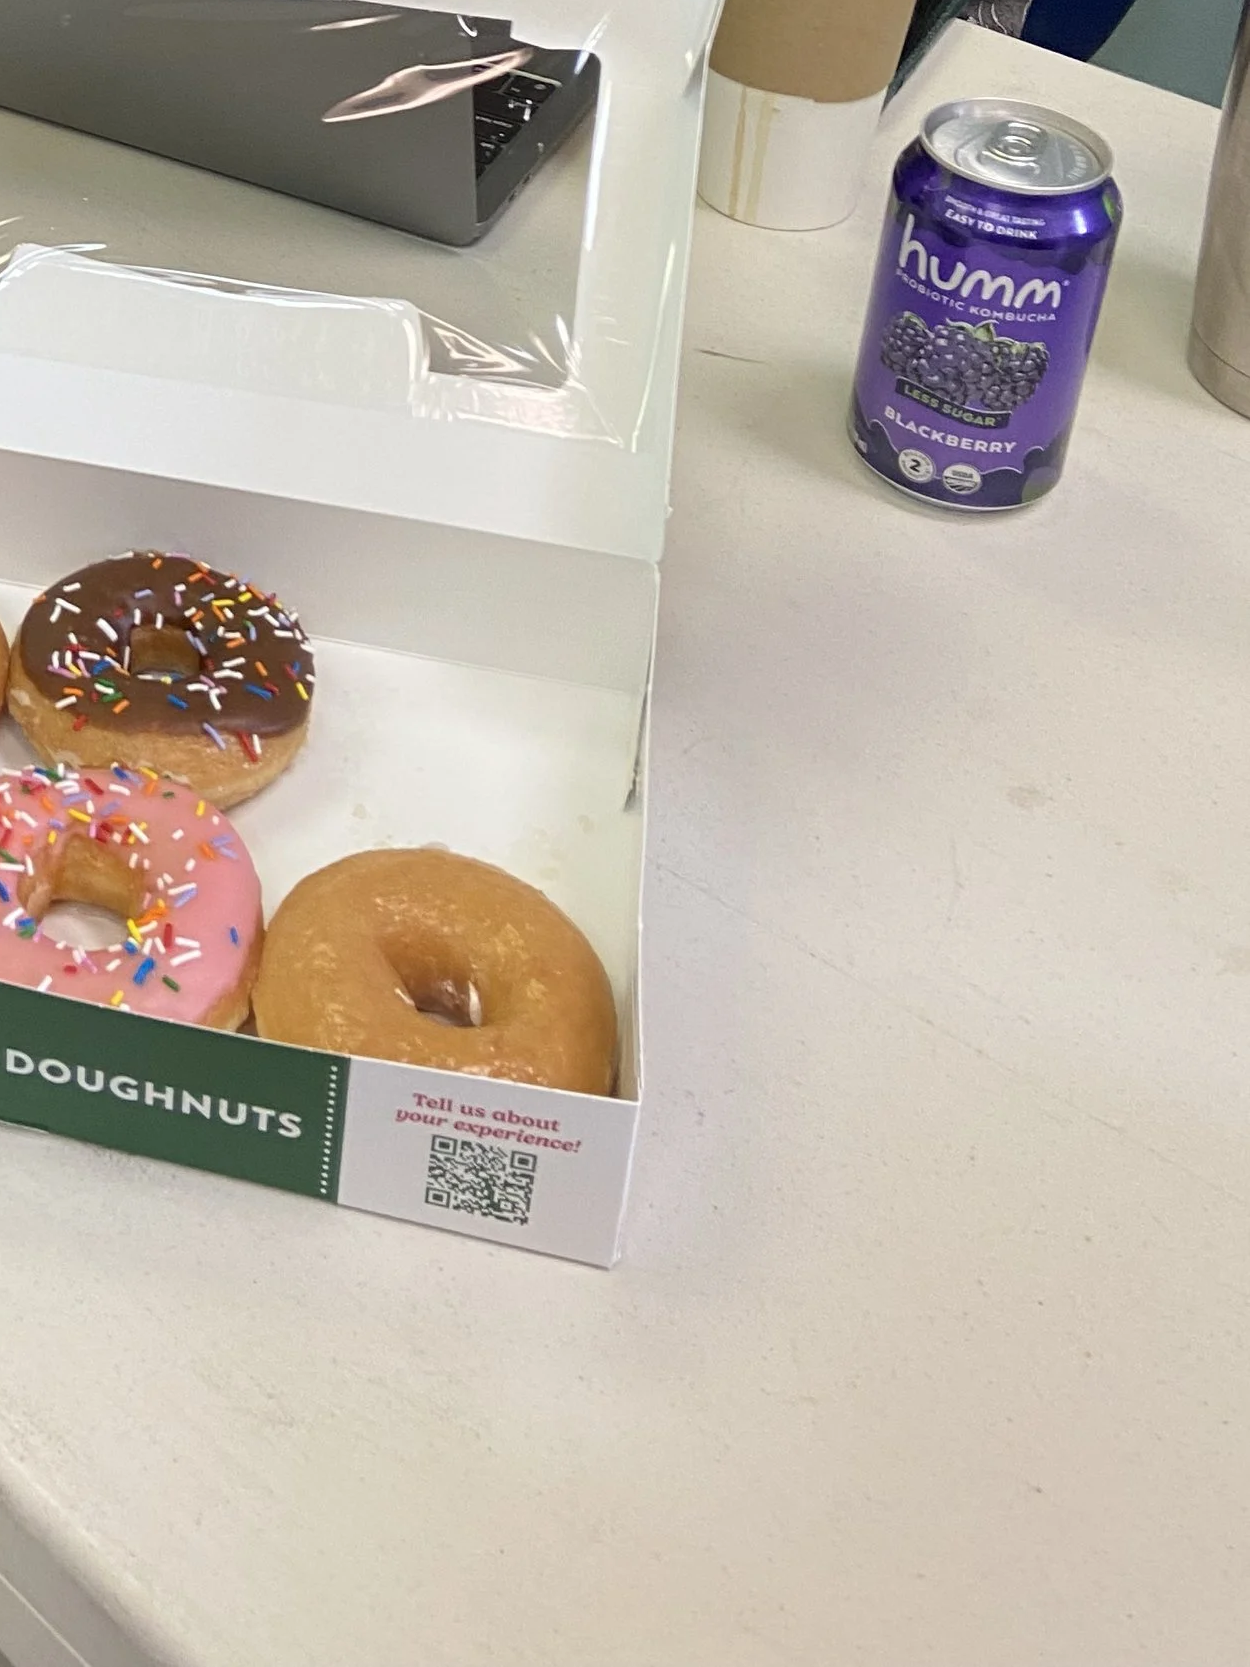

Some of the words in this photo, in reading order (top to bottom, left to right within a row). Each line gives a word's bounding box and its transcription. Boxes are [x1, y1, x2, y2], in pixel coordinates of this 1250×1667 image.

[945, 208, 975, 226] EASY
[977, 219, 995, 233] TO
[996, 224, 1039, 240] DRINK
[1011, 215, 1046, 227] TASTING
[900, 213, 1062, 309] humm
[896, 267, 965, 311] PROBIOTIC
[969, 305, 1057, 323] KOMBUCHA
[904, 385, 940, 408] LESS
[941, 402, 997, 427] SUGAR
[884, 405, 1018, 454] BLACKBERRY
[909, 458, 922, 473] 2
[5, 1047, 304, 1139] DOUGHNUTS
[412, 1091, 453, 1113] Tell
[459, 1102, 486, 1119] us
[491, 1109, 561, 1133] about
[394, 1108, 448, 1128] your
[452, 1119, 583, 1154] experience!
